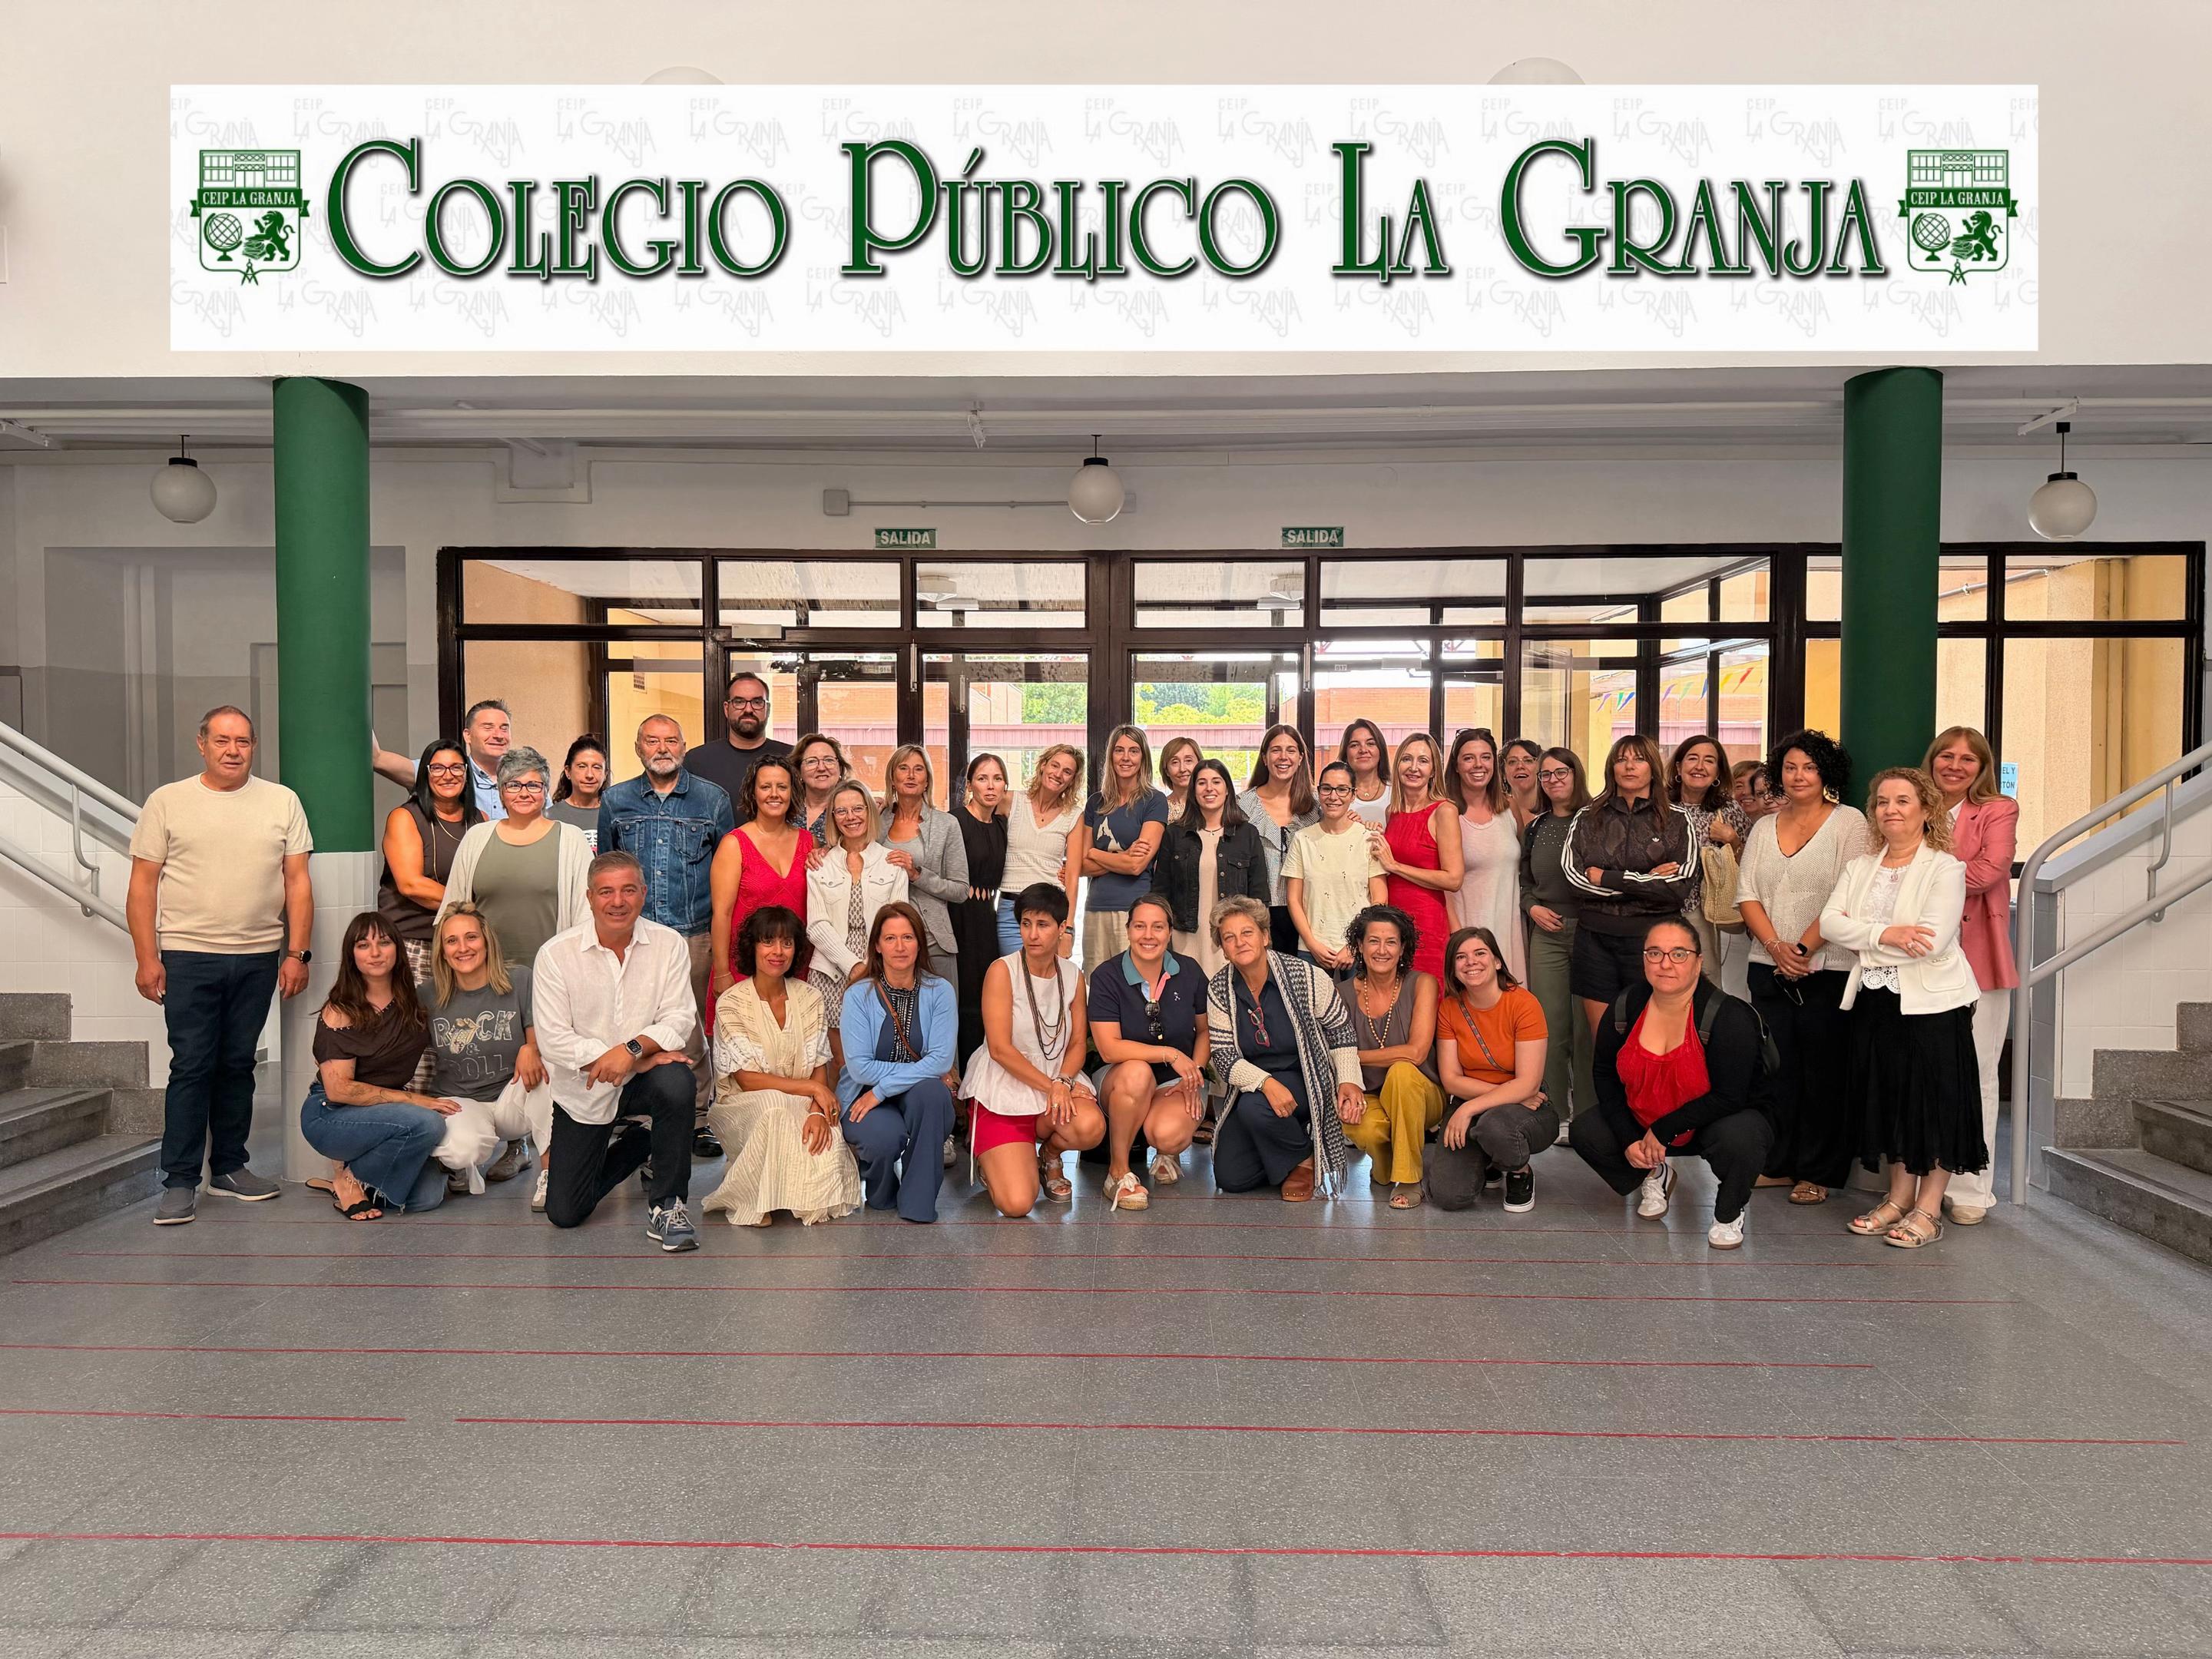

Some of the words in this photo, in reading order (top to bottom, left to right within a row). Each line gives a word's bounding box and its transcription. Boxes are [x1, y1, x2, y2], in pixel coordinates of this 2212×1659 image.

[880, 531, 931, 545] SALIDA
[1287, 529, 1339, 543] SALIDA
[2002, 779, 2015, 789] TÓN
[433, 1010, 516, 1048] RCK
[465, 1042, 480, 1056] &
